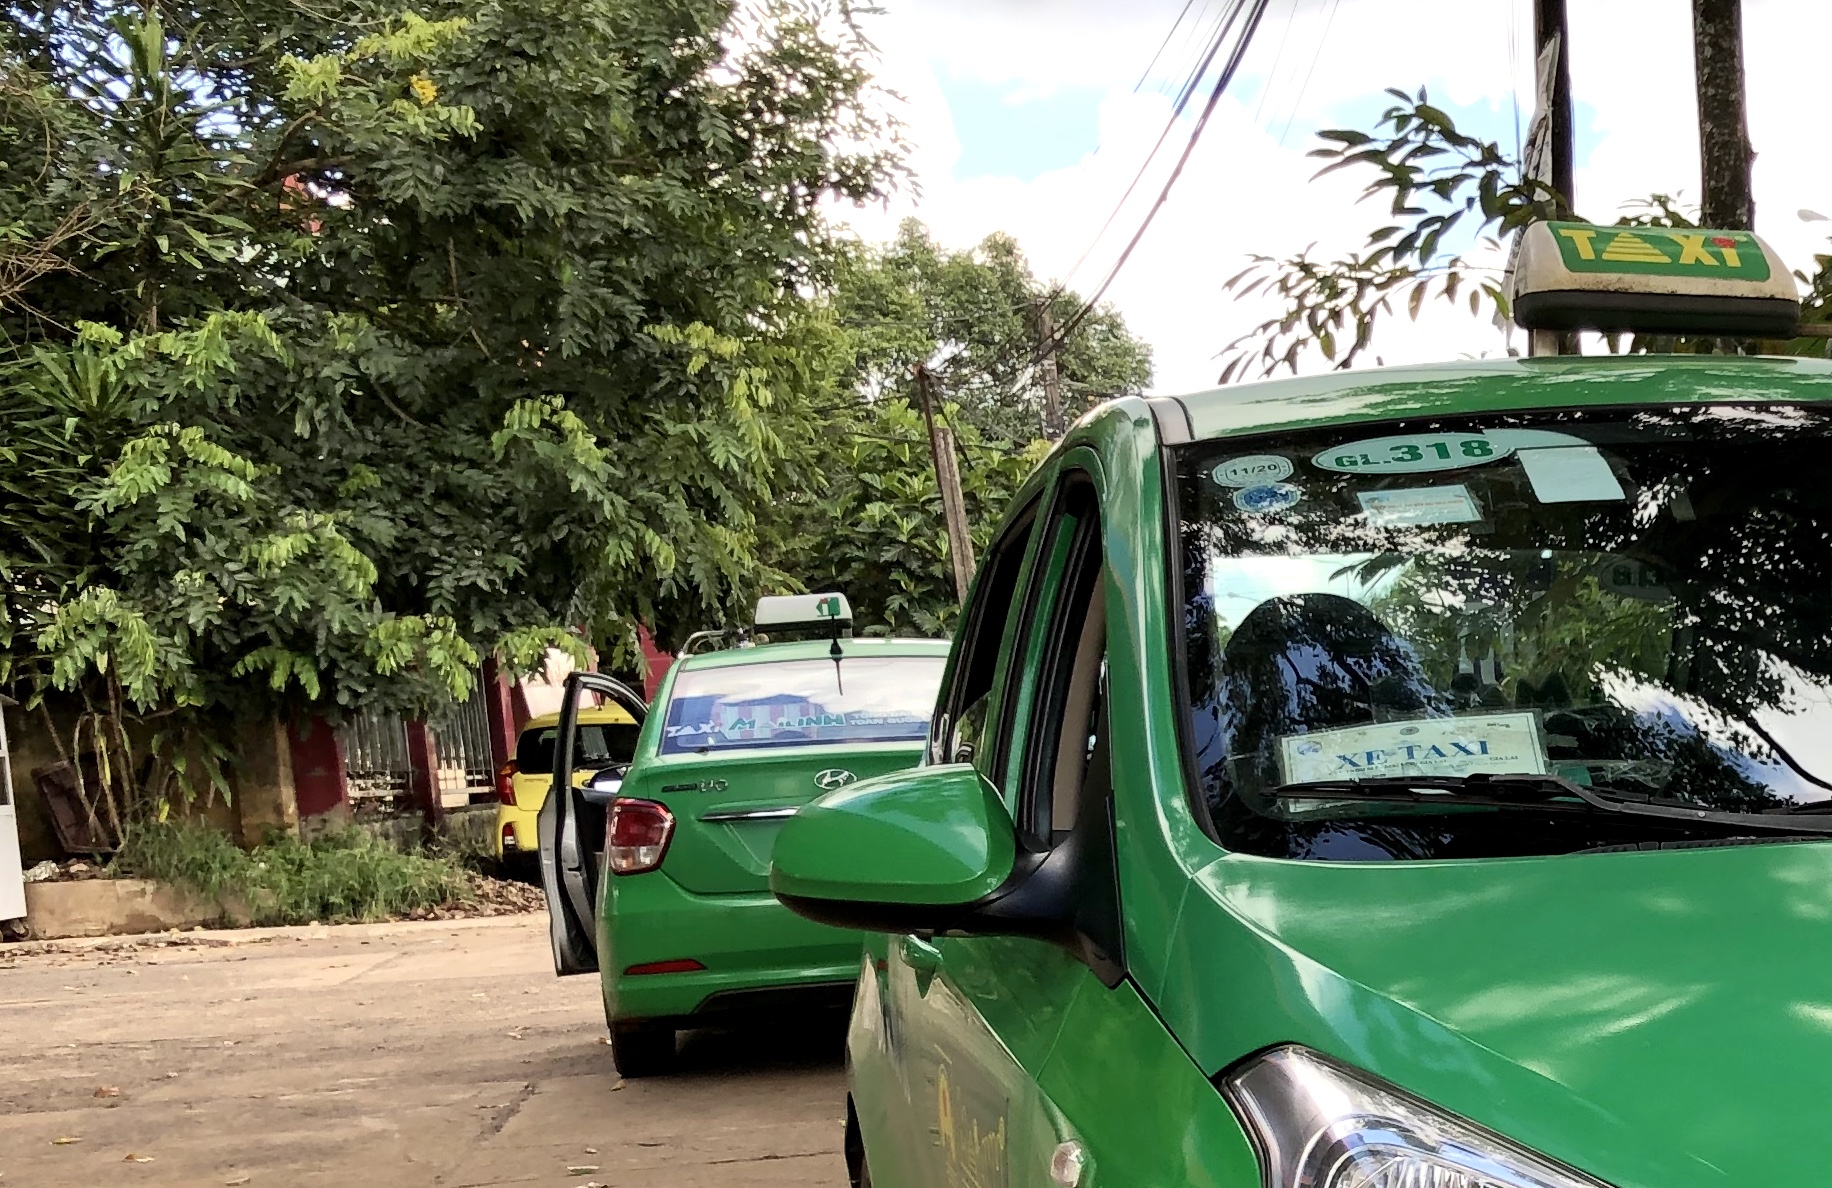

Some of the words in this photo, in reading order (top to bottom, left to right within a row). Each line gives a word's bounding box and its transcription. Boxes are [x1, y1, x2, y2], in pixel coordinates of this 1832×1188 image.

[1334, 439, 1494, 468] GL.318
[1229, 463, 1278, 476] 11/20
[1336, 750, 1387, 770] XE
[1398, 740, 1489, 761] TAXI
